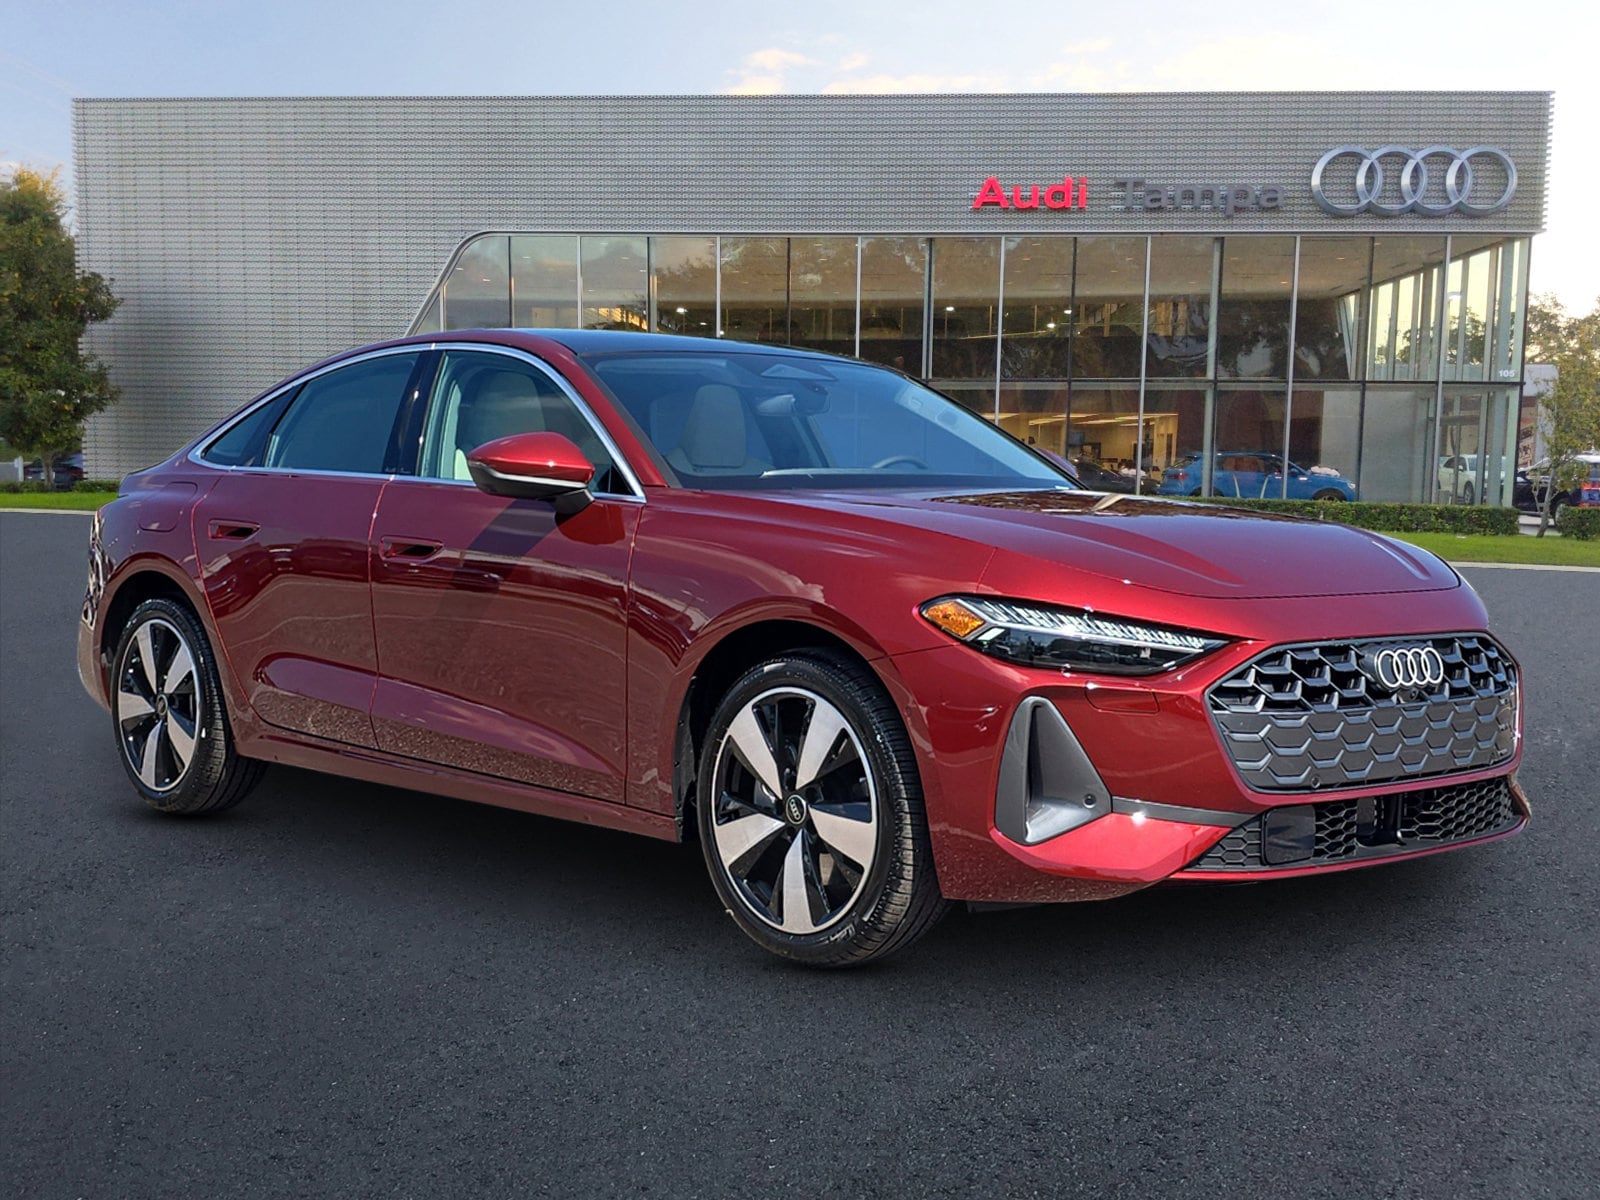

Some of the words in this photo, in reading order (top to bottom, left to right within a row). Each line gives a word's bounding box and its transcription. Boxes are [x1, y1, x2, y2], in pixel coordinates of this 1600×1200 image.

[972, 175, 1088, 211] Audi
[1114, 177, 1282, 217] Tampa
[1499, 369, 1515, 378] 105
